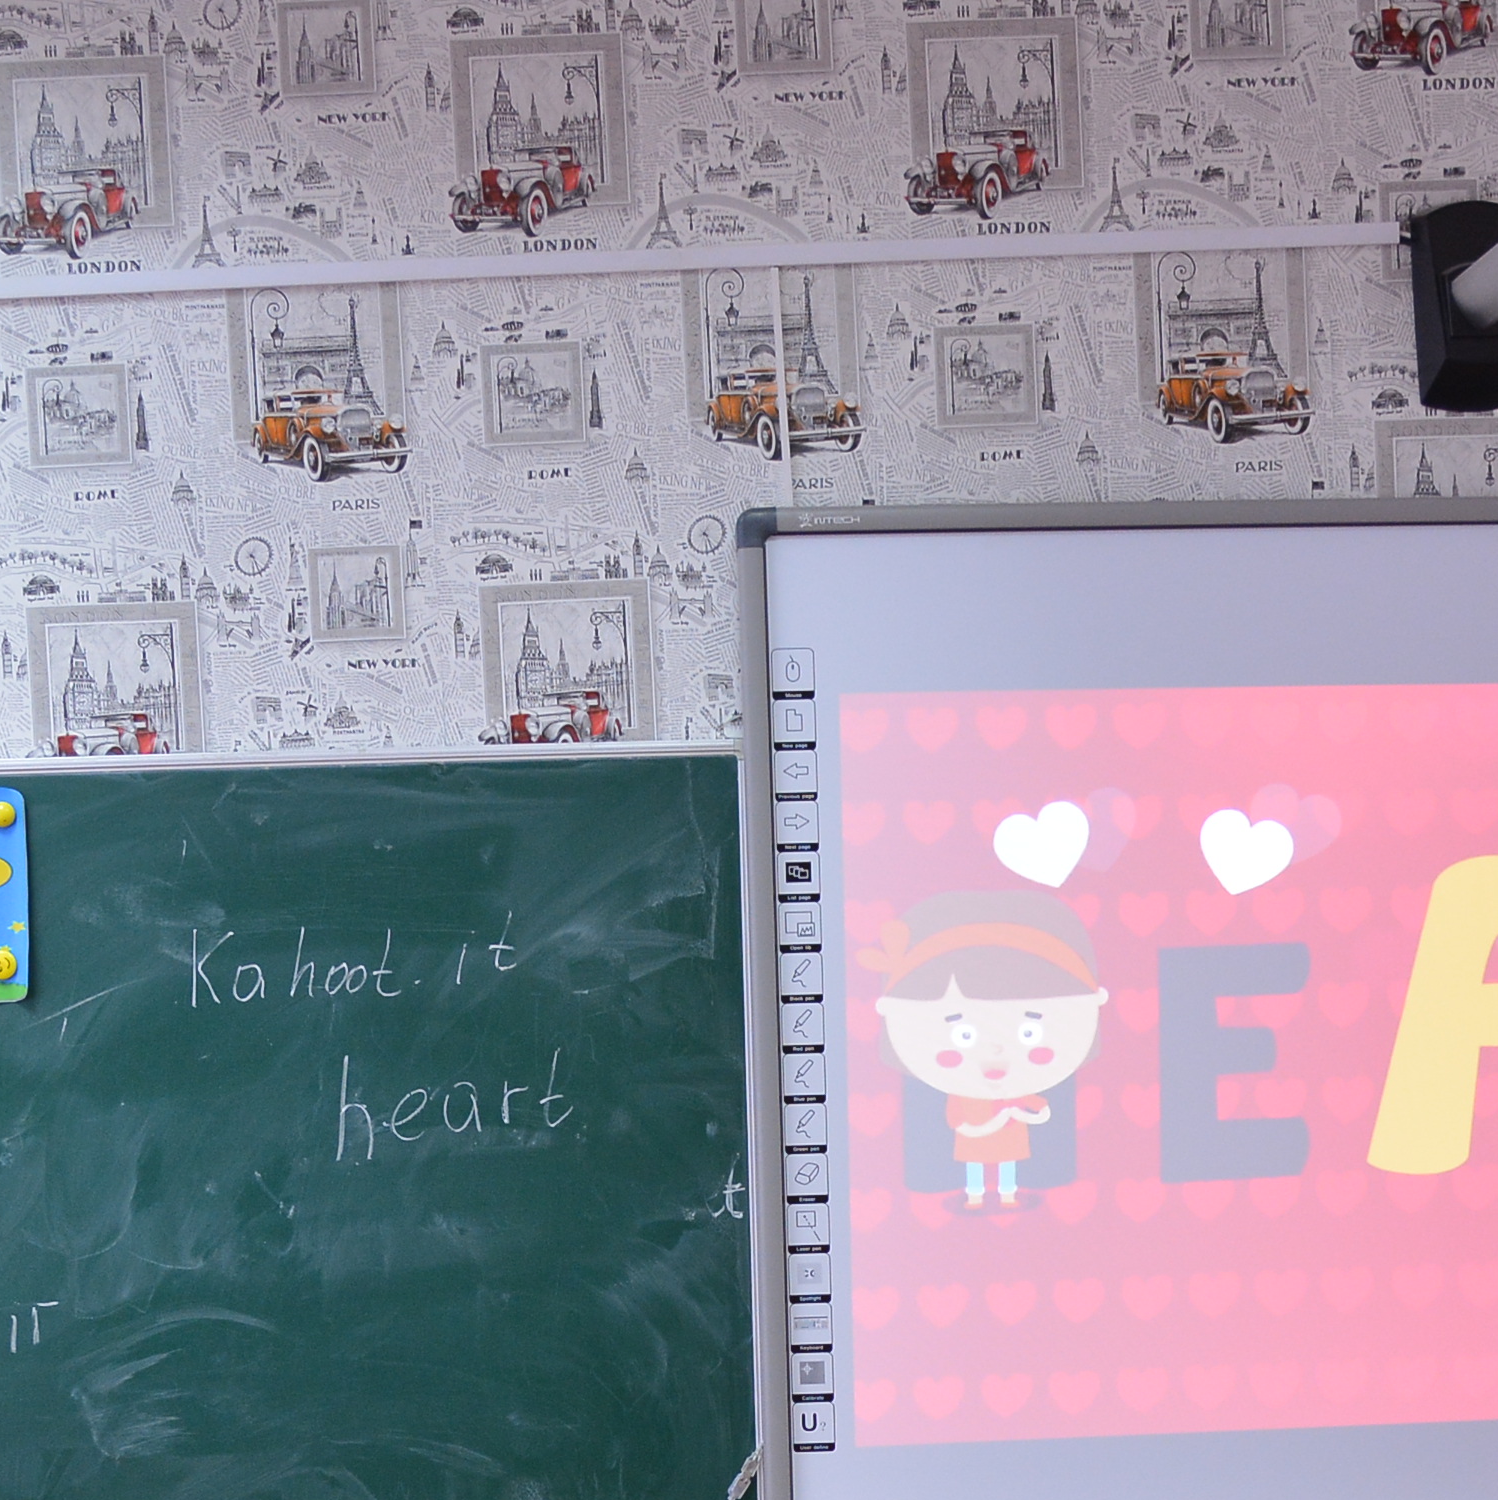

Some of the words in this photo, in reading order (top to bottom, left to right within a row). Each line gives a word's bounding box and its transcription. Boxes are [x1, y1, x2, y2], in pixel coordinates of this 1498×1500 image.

[1227, 78, 1257, 88] NEW
[1261, 77, 1298, 87] YORK
[1422, 77, 1495, 90] LONDON
[775, 92, 805, 102] NEW
[809, 91, 847, 101] YORK
[317, 113, 347, 124] NEW
[352, 112, 388, 122] YORK
[977, 221, 1051, 236] LONDON
[523, 238, 598, 253] LONDON
[66, 259, 142, 275] LONDON
[981, 450, 1024, 461] ROME
[1235, 461, 1283, 472] PARIS
[528, 468, 571, 480] ROME
[74, 490, 118, 501] ROME
[332, 498, 381, 511] PARIS
[347, 659, 378, 670] NEW
[382, 658, 421, 669] YORK
[335, 1047, 573, 1161] heart
